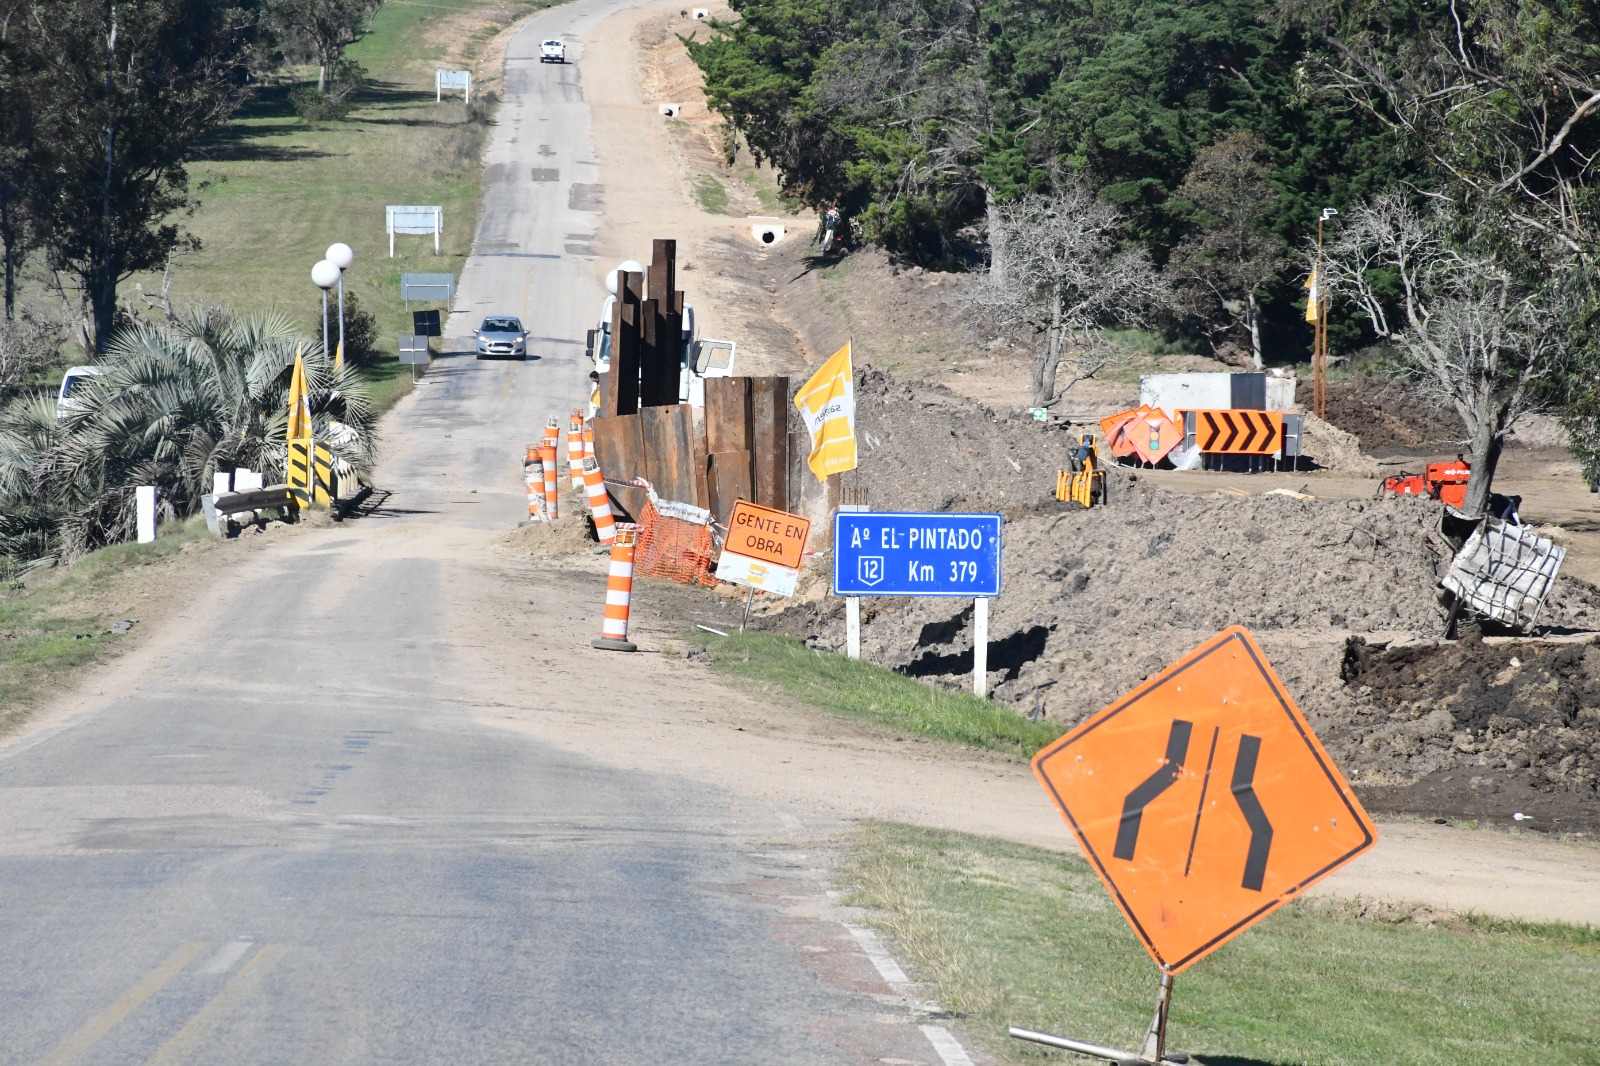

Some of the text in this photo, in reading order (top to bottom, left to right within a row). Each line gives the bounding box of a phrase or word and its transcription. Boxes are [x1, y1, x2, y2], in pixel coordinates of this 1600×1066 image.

[737, 513, 805, 541] GENTE EN
[746, 536, 784, 556] OBRA
[909, 528, 982, 549] PINTADO
[864, 560, 978, 582] 12 Km 379
